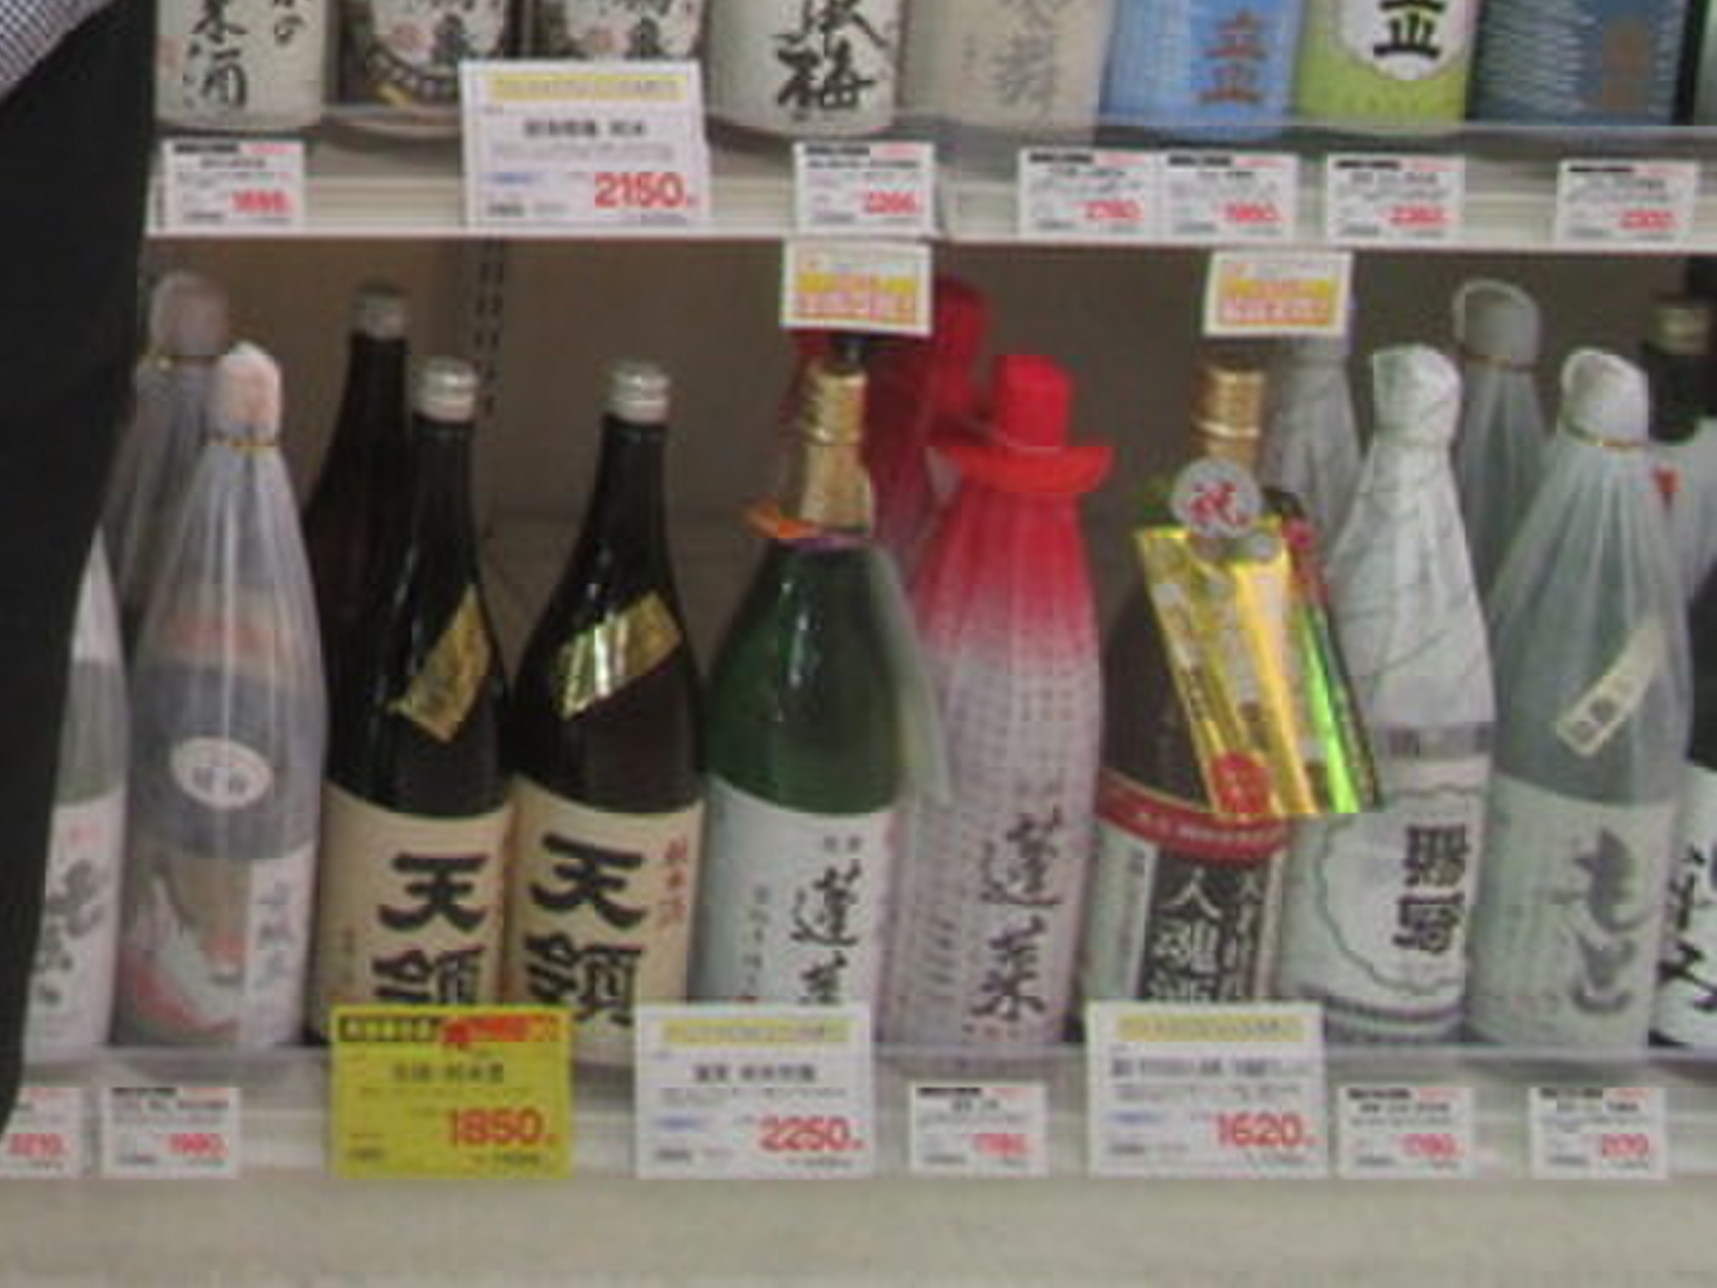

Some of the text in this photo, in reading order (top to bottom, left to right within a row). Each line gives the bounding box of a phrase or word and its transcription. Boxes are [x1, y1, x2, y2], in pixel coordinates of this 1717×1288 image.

[594, 172, 684, 208] 2150
[447, 1108, 542, 1147] 1850
[759, 1116, 851, 1153] 2250
[1216, 1114, 1302, 1152] 1620
